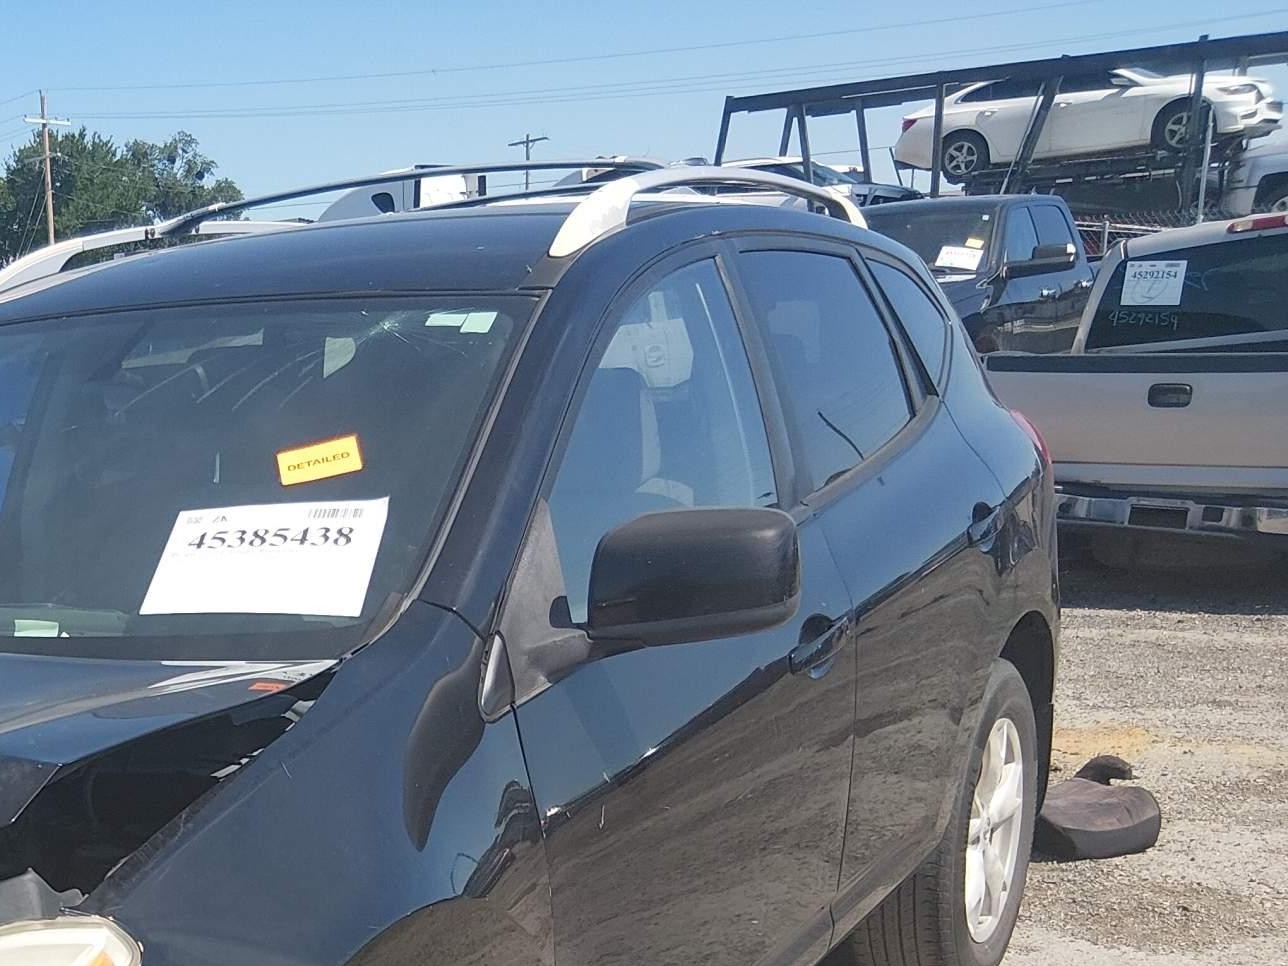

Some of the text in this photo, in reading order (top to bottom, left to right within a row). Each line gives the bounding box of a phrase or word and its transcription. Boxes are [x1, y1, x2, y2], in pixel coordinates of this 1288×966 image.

[1130, 270, 1179, 281] 45292154
[287, 451, 352, 473] DETAILED
[187, 526, 355, 550] 45385438
